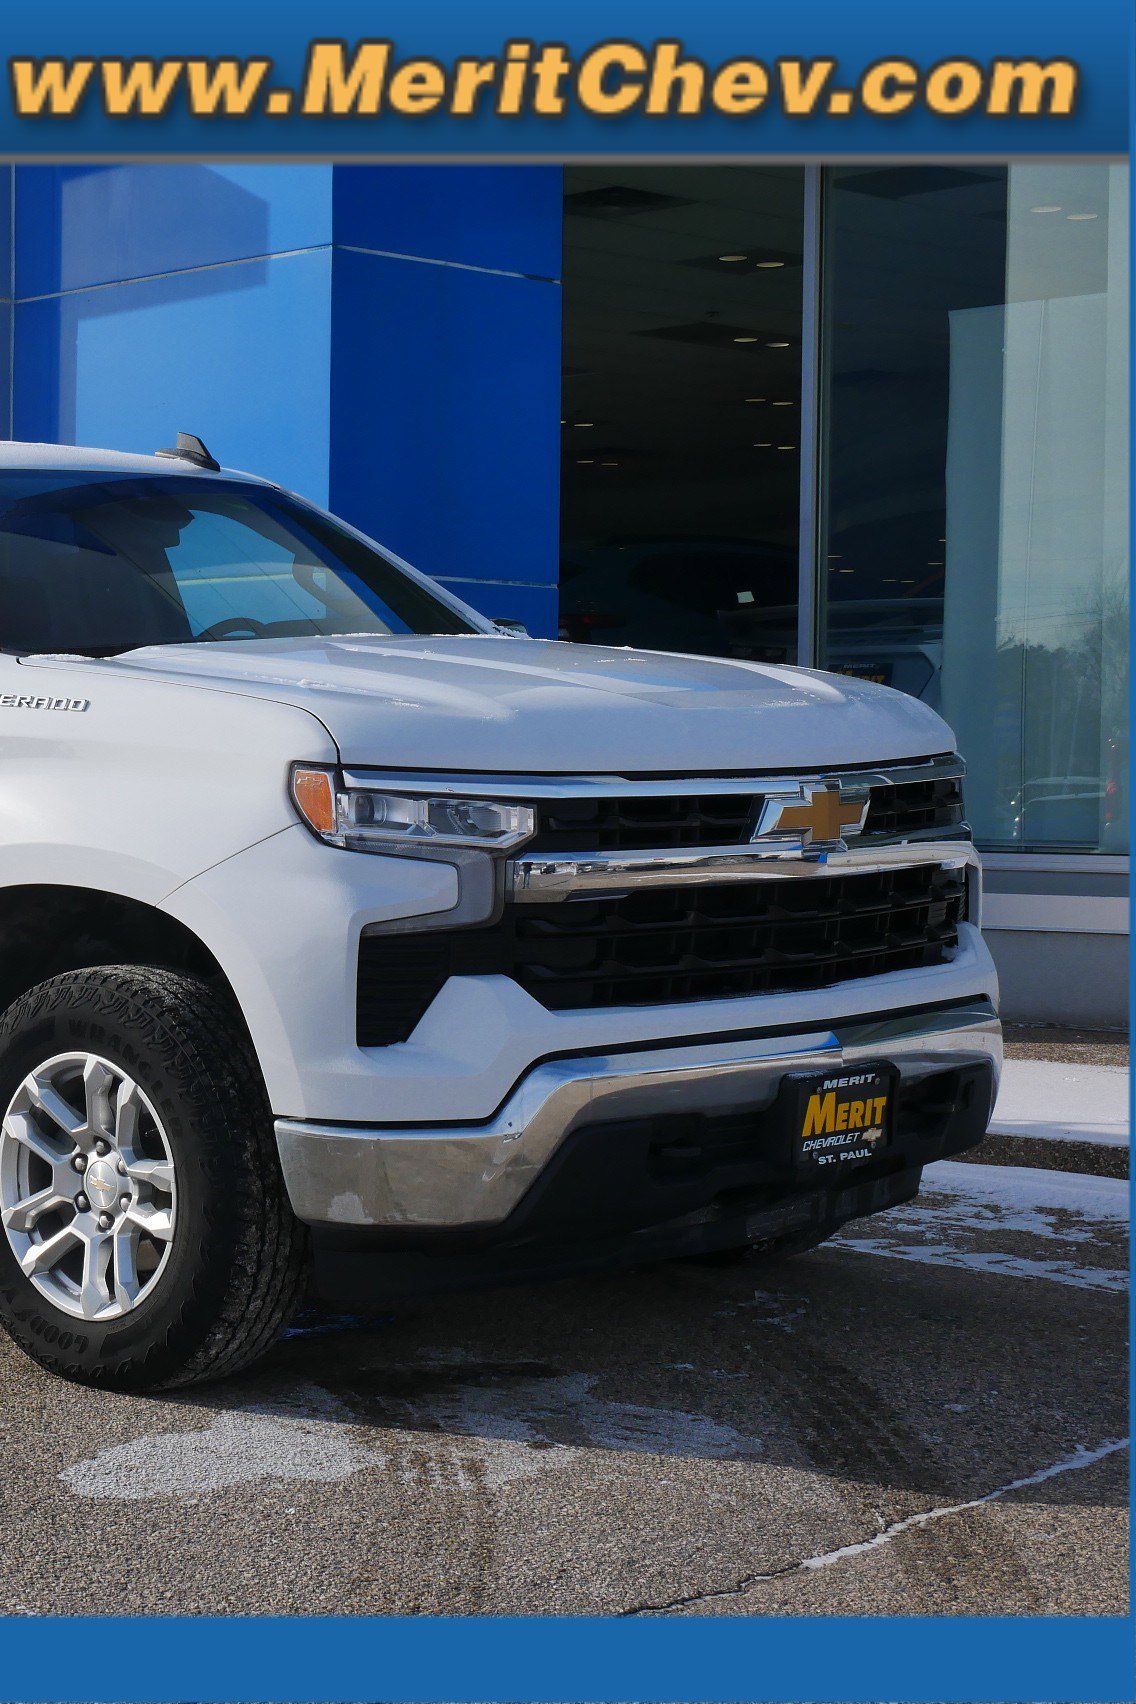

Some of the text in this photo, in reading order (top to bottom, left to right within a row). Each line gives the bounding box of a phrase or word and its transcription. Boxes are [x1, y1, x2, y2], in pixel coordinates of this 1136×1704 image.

[823, 1073, 876, 1089] MERIT
[802, 1092, 887, 1137] MERIT
[802, 1132, 861, 1151] CHEVROLET
[818, 1149, 872, 1165] ST. PAUL
